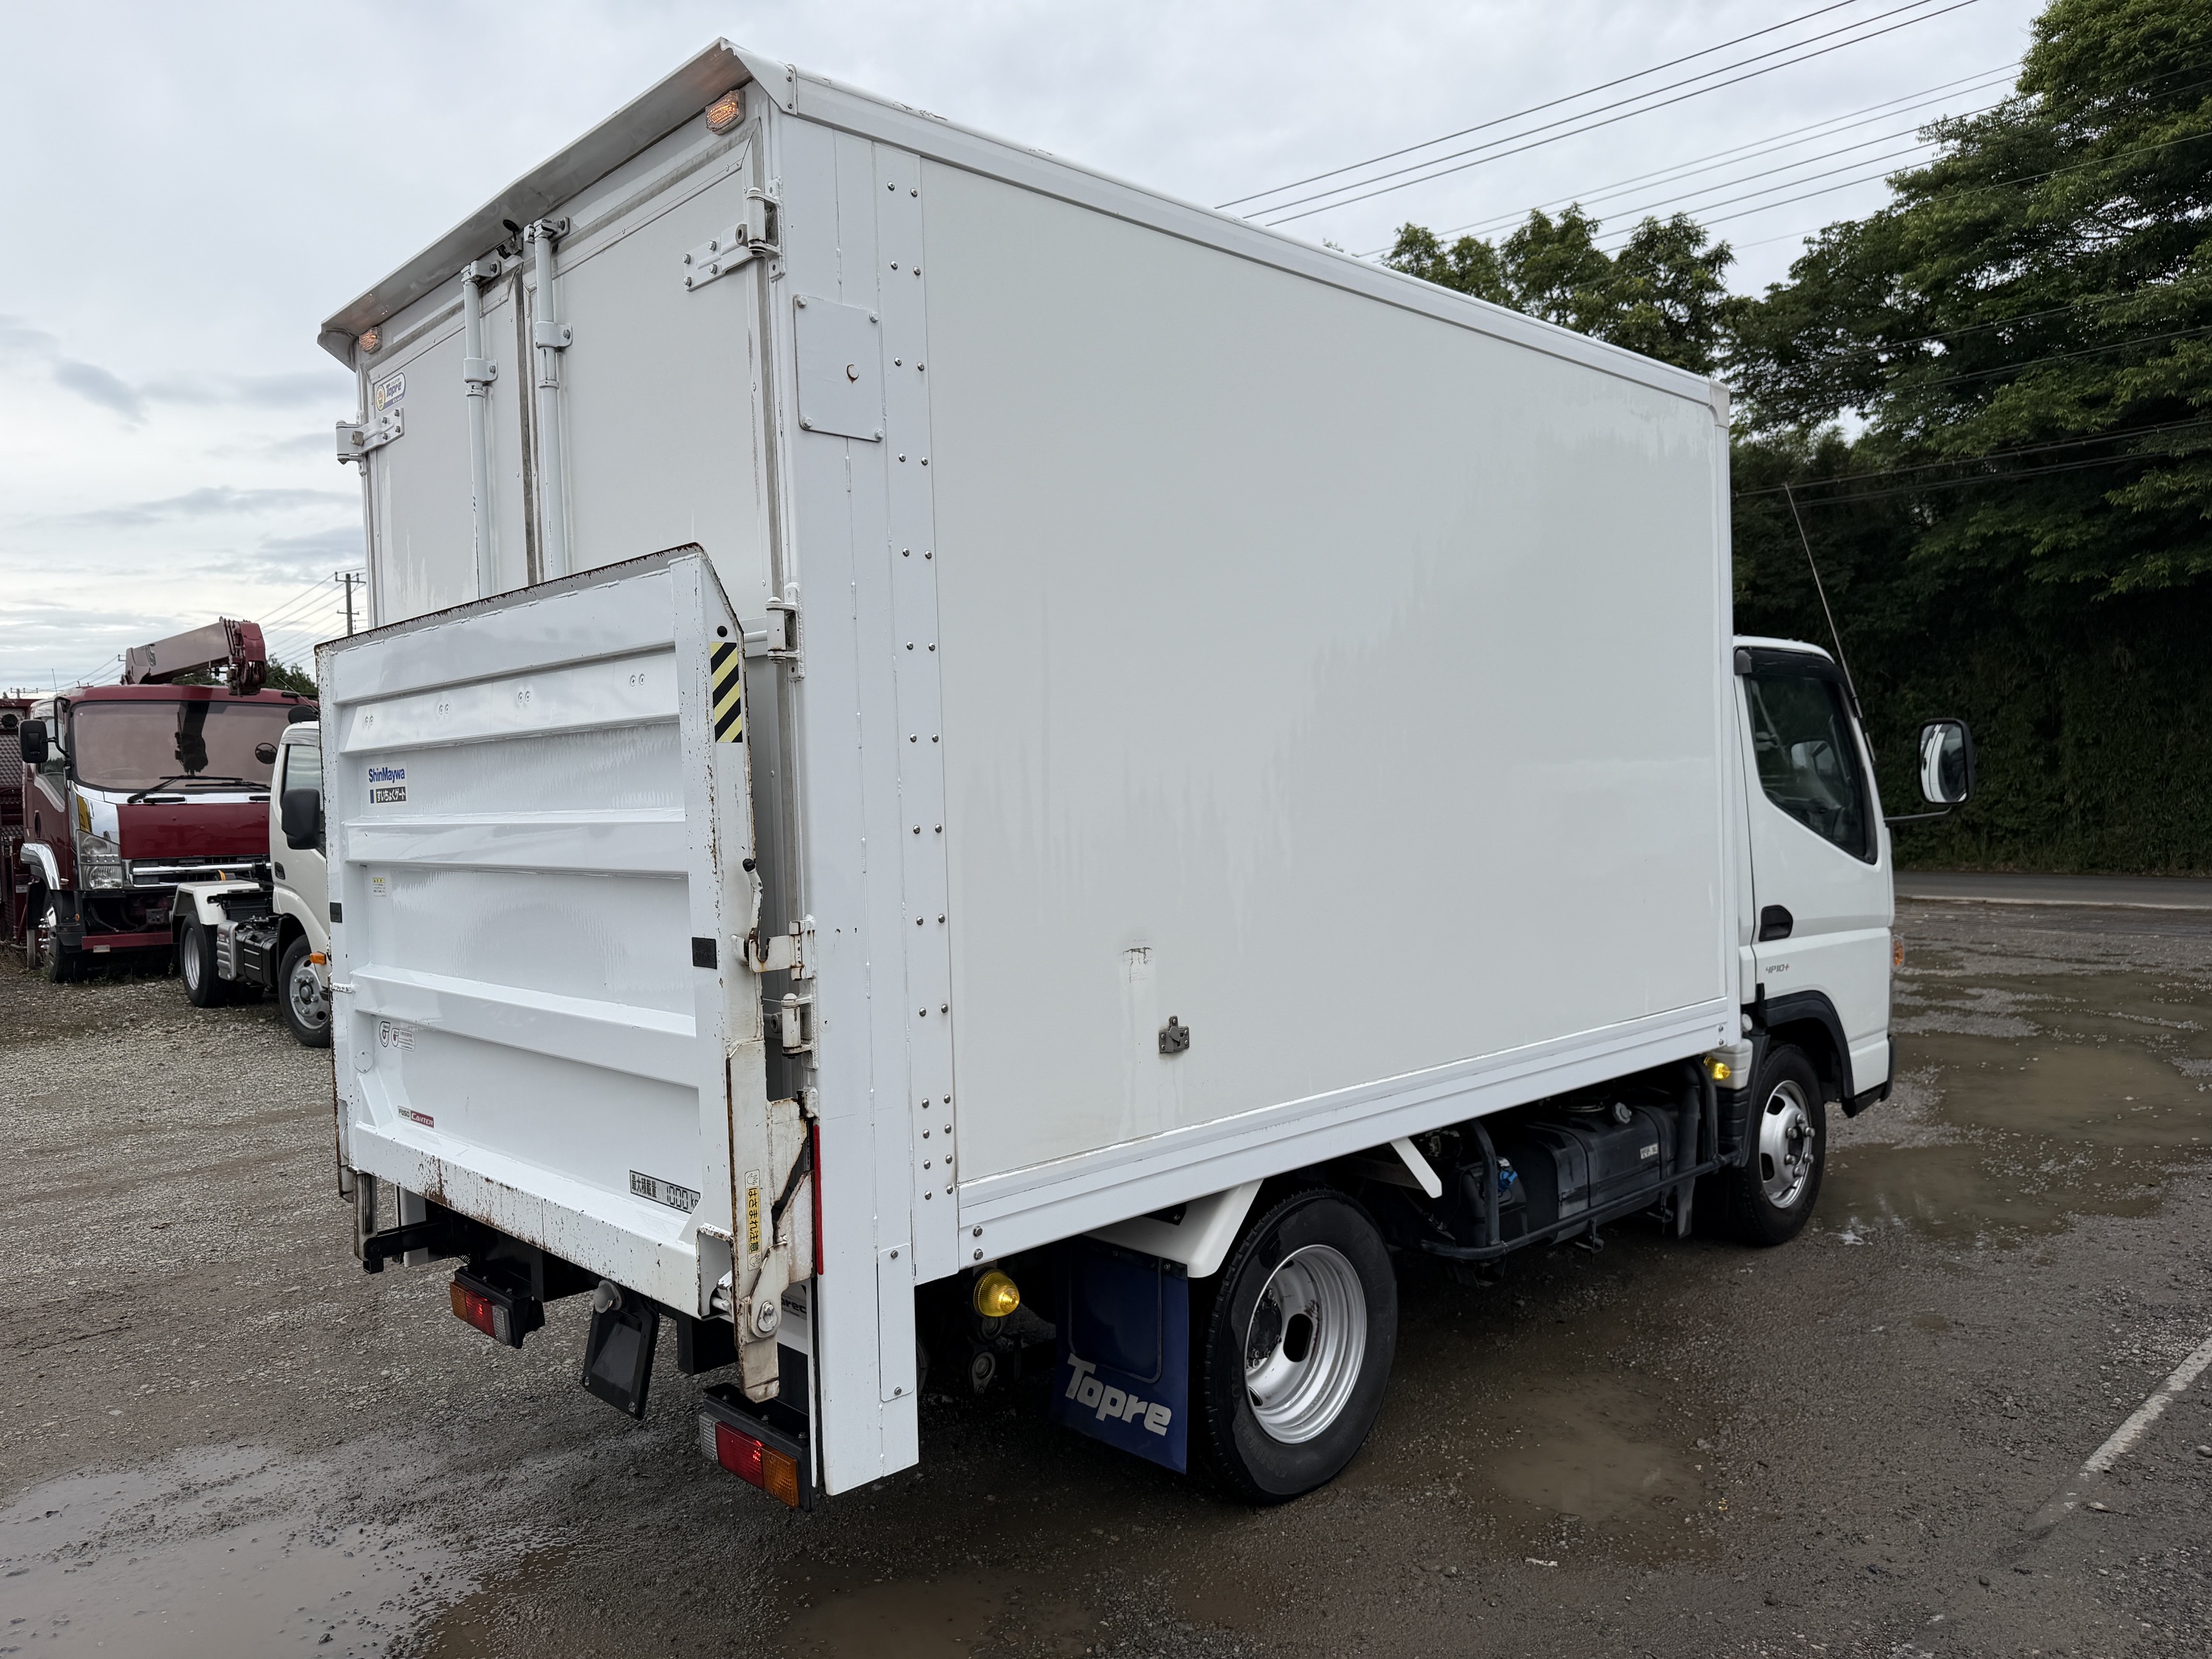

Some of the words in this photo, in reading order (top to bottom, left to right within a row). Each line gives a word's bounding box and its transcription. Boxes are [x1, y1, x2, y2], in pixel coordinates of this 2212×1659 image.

[386, 381, 402, 398] Topre
[369, 767, 405, 783] ShinMaywa
[376, 787, 406, 802] すいちょくゲート
[398, 1108, 410, 1118] FUSO
[411, 1112, 434, 1126] CANTER
[631, 1173, 658, 1198] 最大積載量
[666, 1184, 689, 1211] 1000
[747, 1187, 761, 1253] はさまれ注意
[1065, 1352, 1172, 1437] Topre
